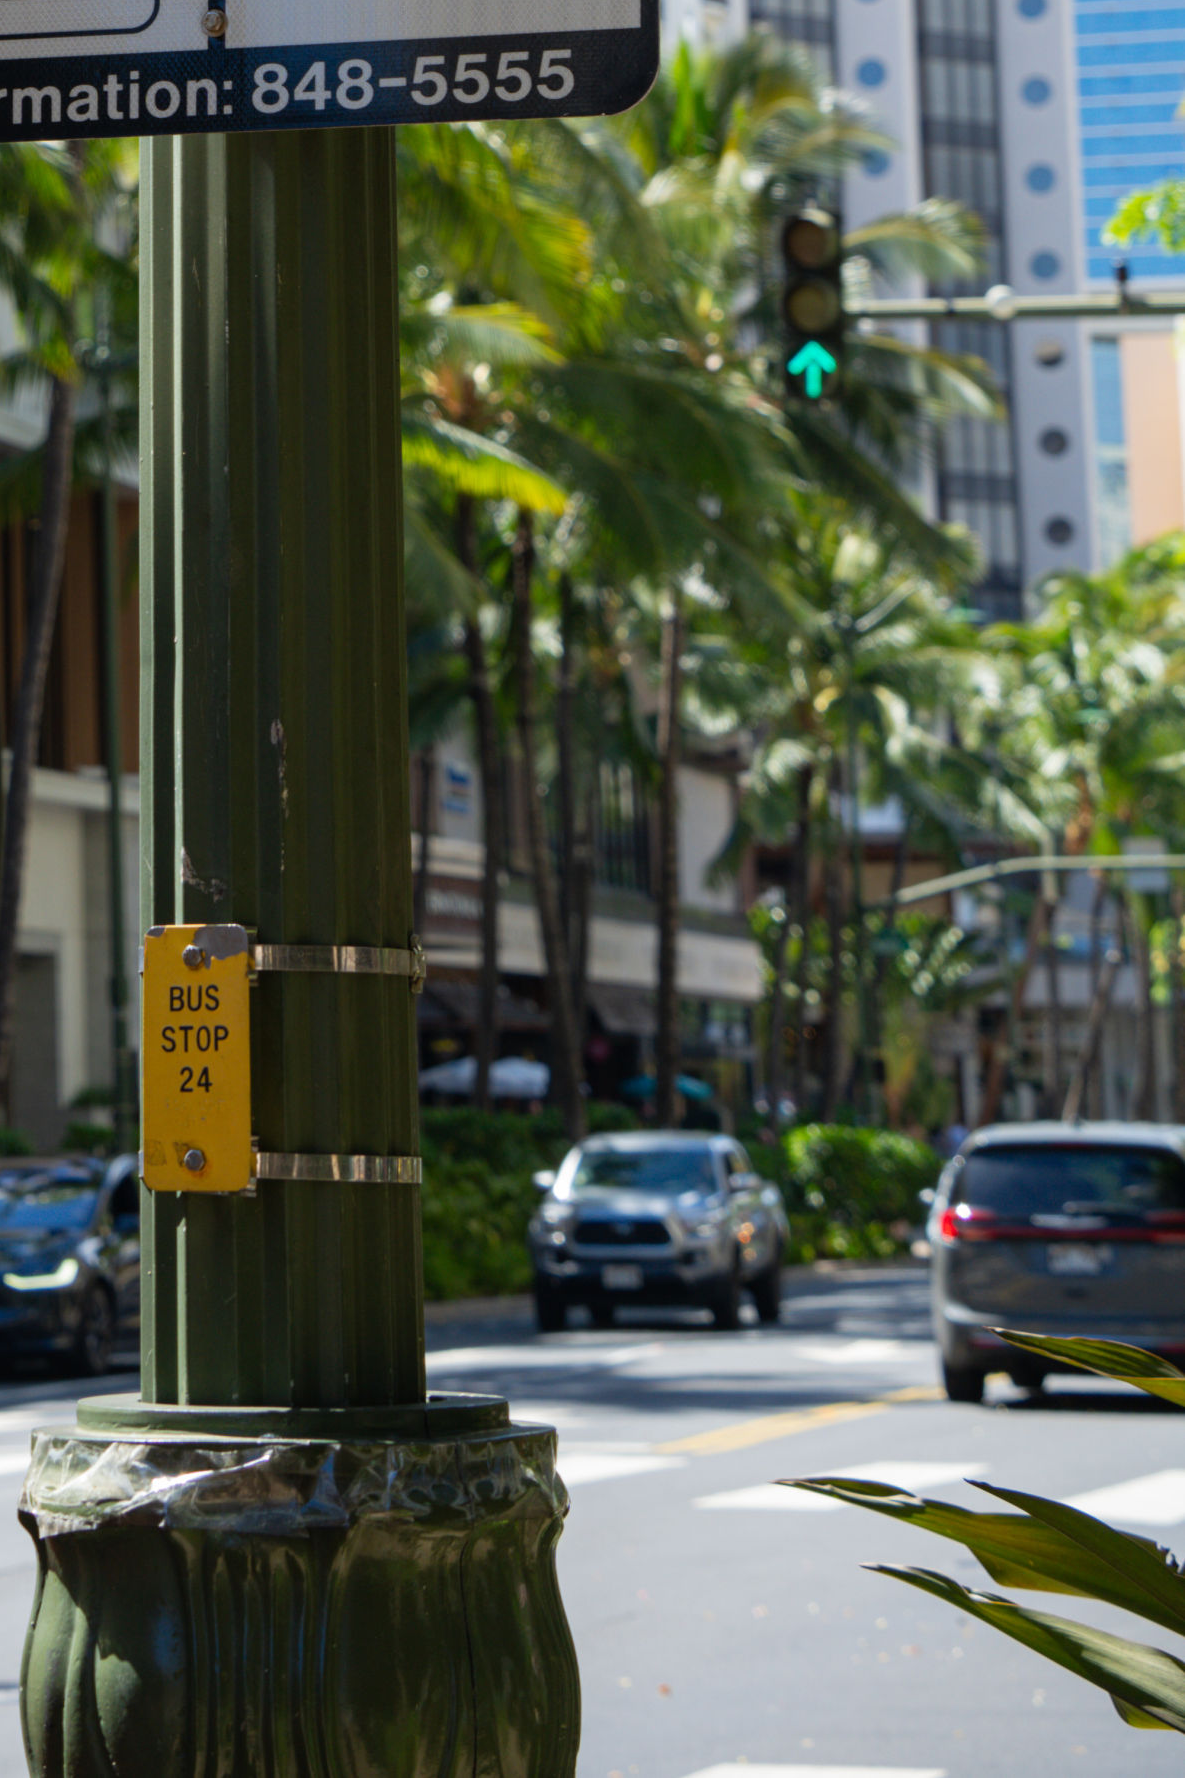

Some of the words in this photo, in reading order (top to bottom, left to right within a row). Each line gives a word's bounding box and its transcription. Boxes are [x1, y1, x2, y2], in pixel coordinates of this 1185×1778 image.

[251, 49, 574, 114] 848-5555
[170, 984, 220, 1012] BUS
[161, 1025, 229, 1052] STOP
[180, 1066, 213, 1092] 24
